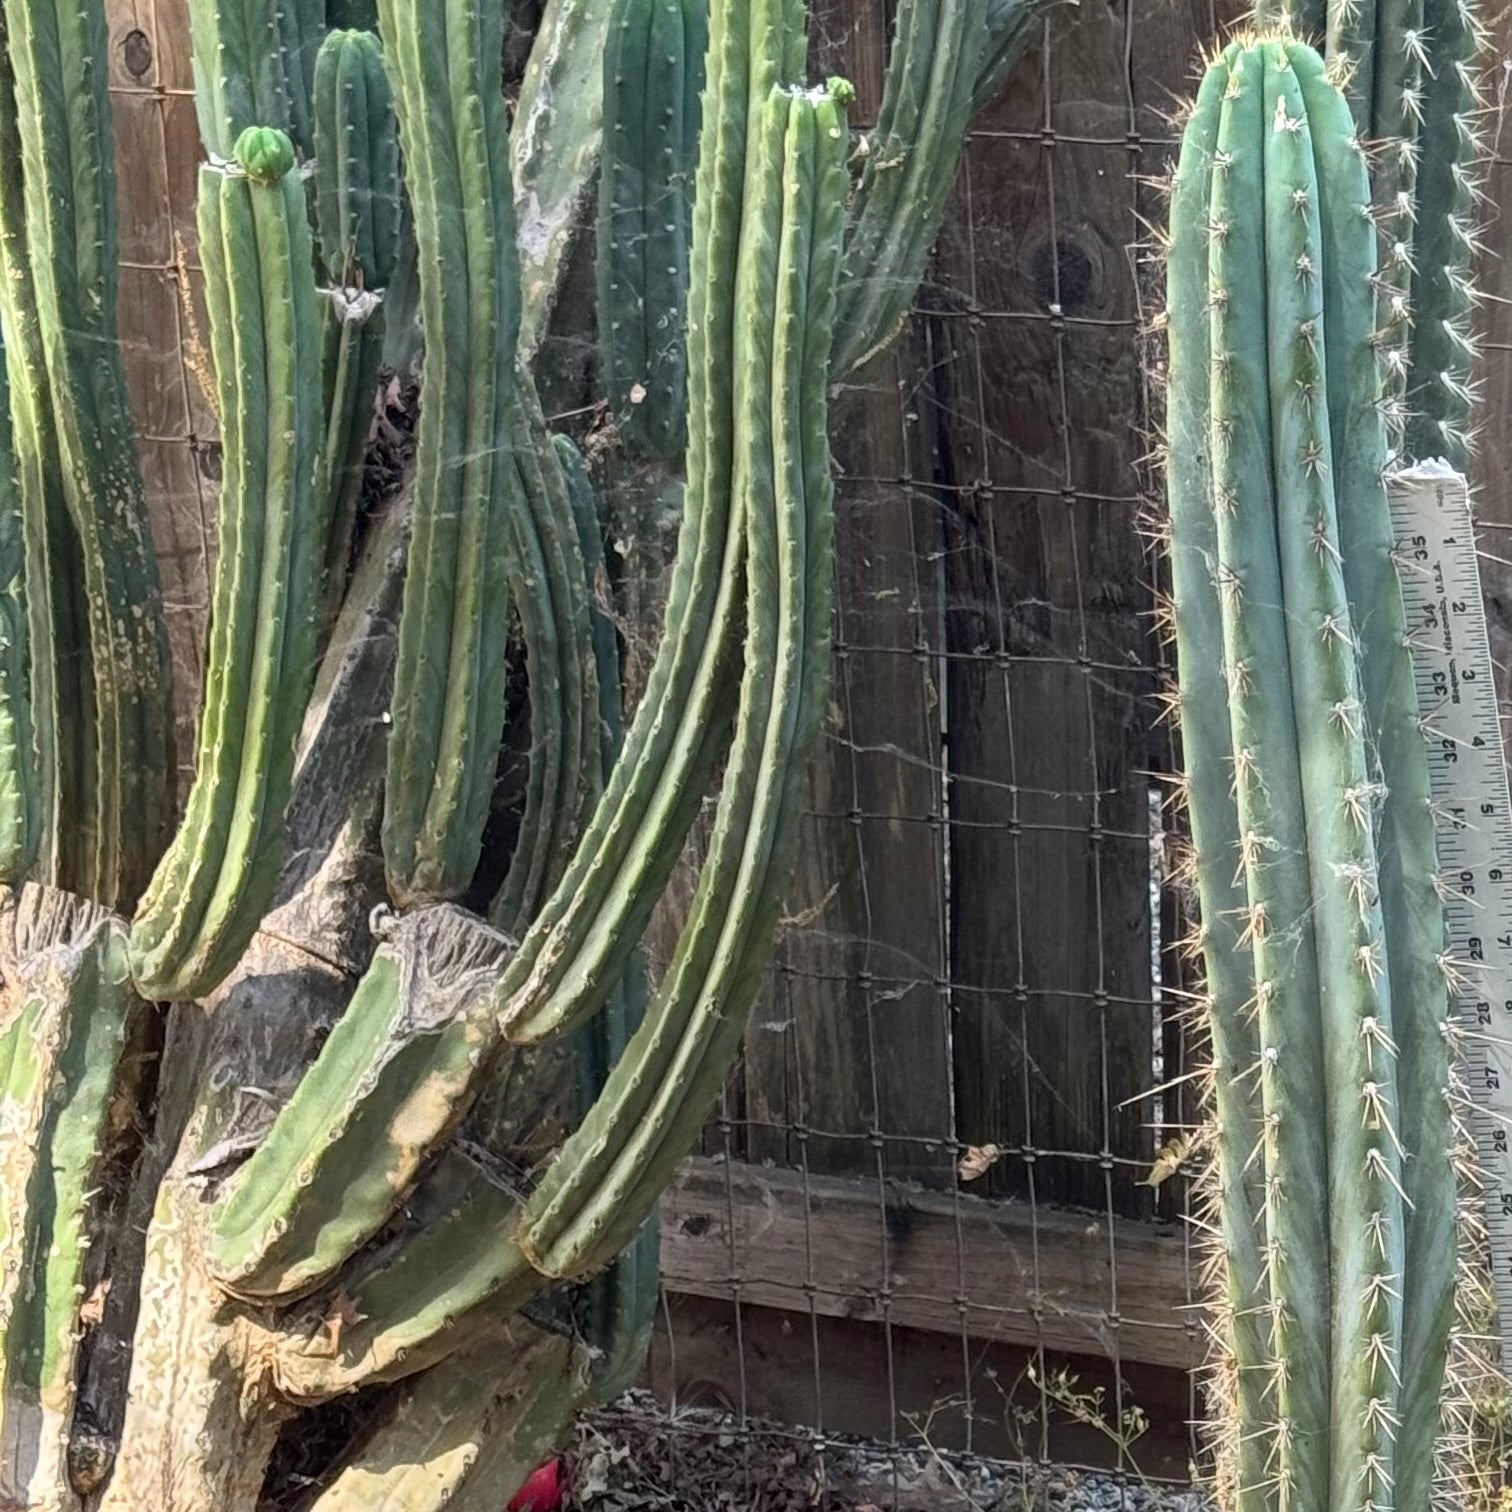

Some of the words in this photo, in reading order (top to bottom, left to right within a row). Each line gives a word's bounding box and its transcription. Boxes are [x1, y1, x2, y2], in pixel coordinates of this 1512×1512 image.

[1412, 536, 1428, 561] 35
[1423, 603, 1438, 628] 34
[1452, 602, 1466, 613] 2
[1433, 672, 1447, 696] 33
[1462, 670, 1475, 680] 3
[1442, 739, 1457, 763] 32
[1472, 736, 1485, 748] 4
[1481, 804, 1494, 814] 5
[1461, 872, 1475, 895] 30
[1489, 870, 1503, 880] 6
[1469, 938, 1483, 960] 29
[1497, 935, 1512, 946] 7
[1477, 1002, 1492, 1025] 28
[1485, 1067, 1500, 1089] 27
[1493, 1130, 1507, 1152] 26
